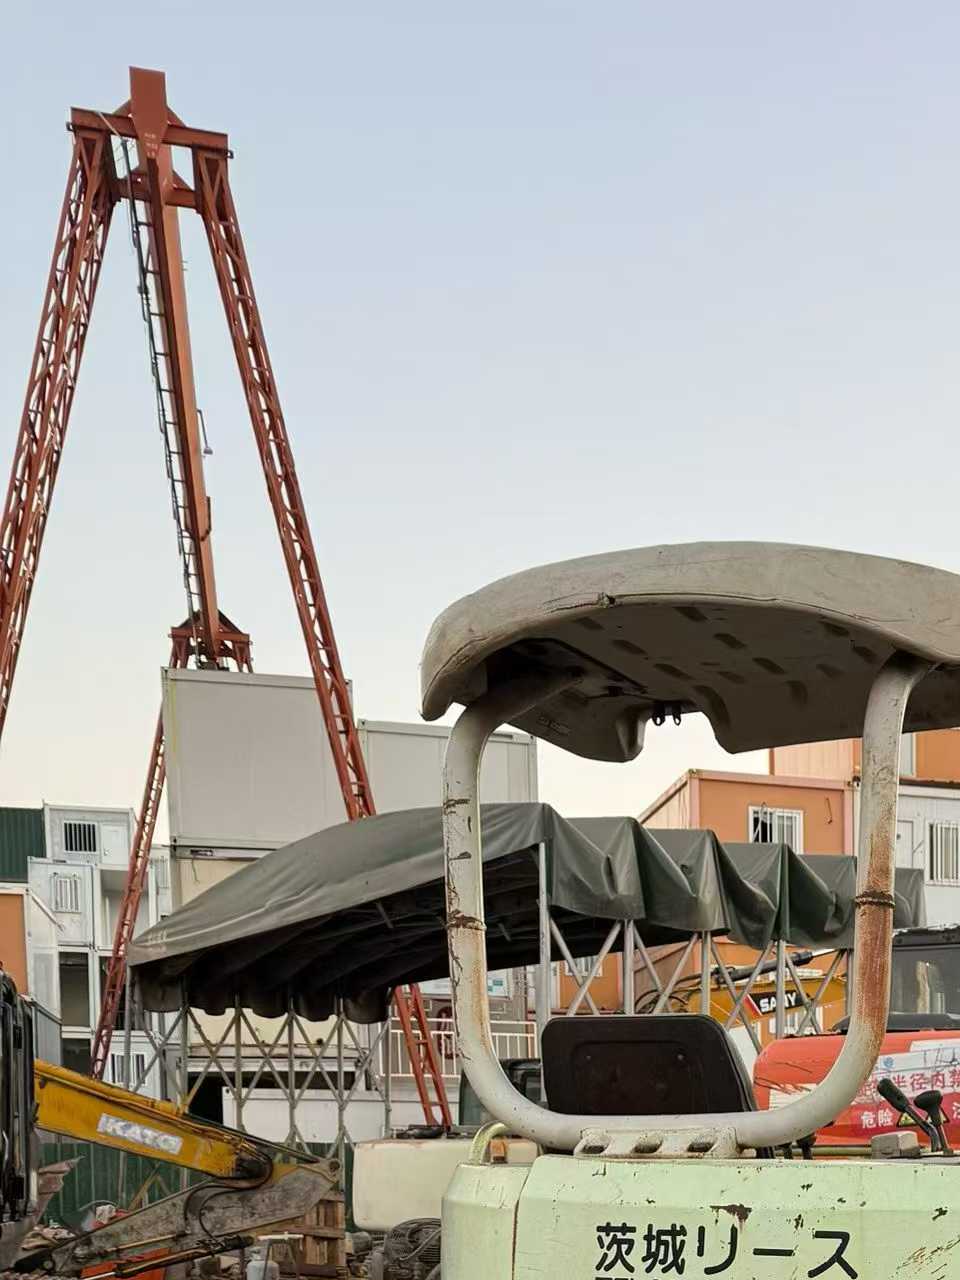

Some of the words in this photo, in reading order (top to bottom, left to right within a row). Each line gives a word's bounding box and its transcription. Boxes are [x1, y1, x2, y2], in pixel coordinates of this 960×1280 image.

[861, 1108, 893, 1128] 危险
[595, 1221, 858, 1279] 茨城リース
